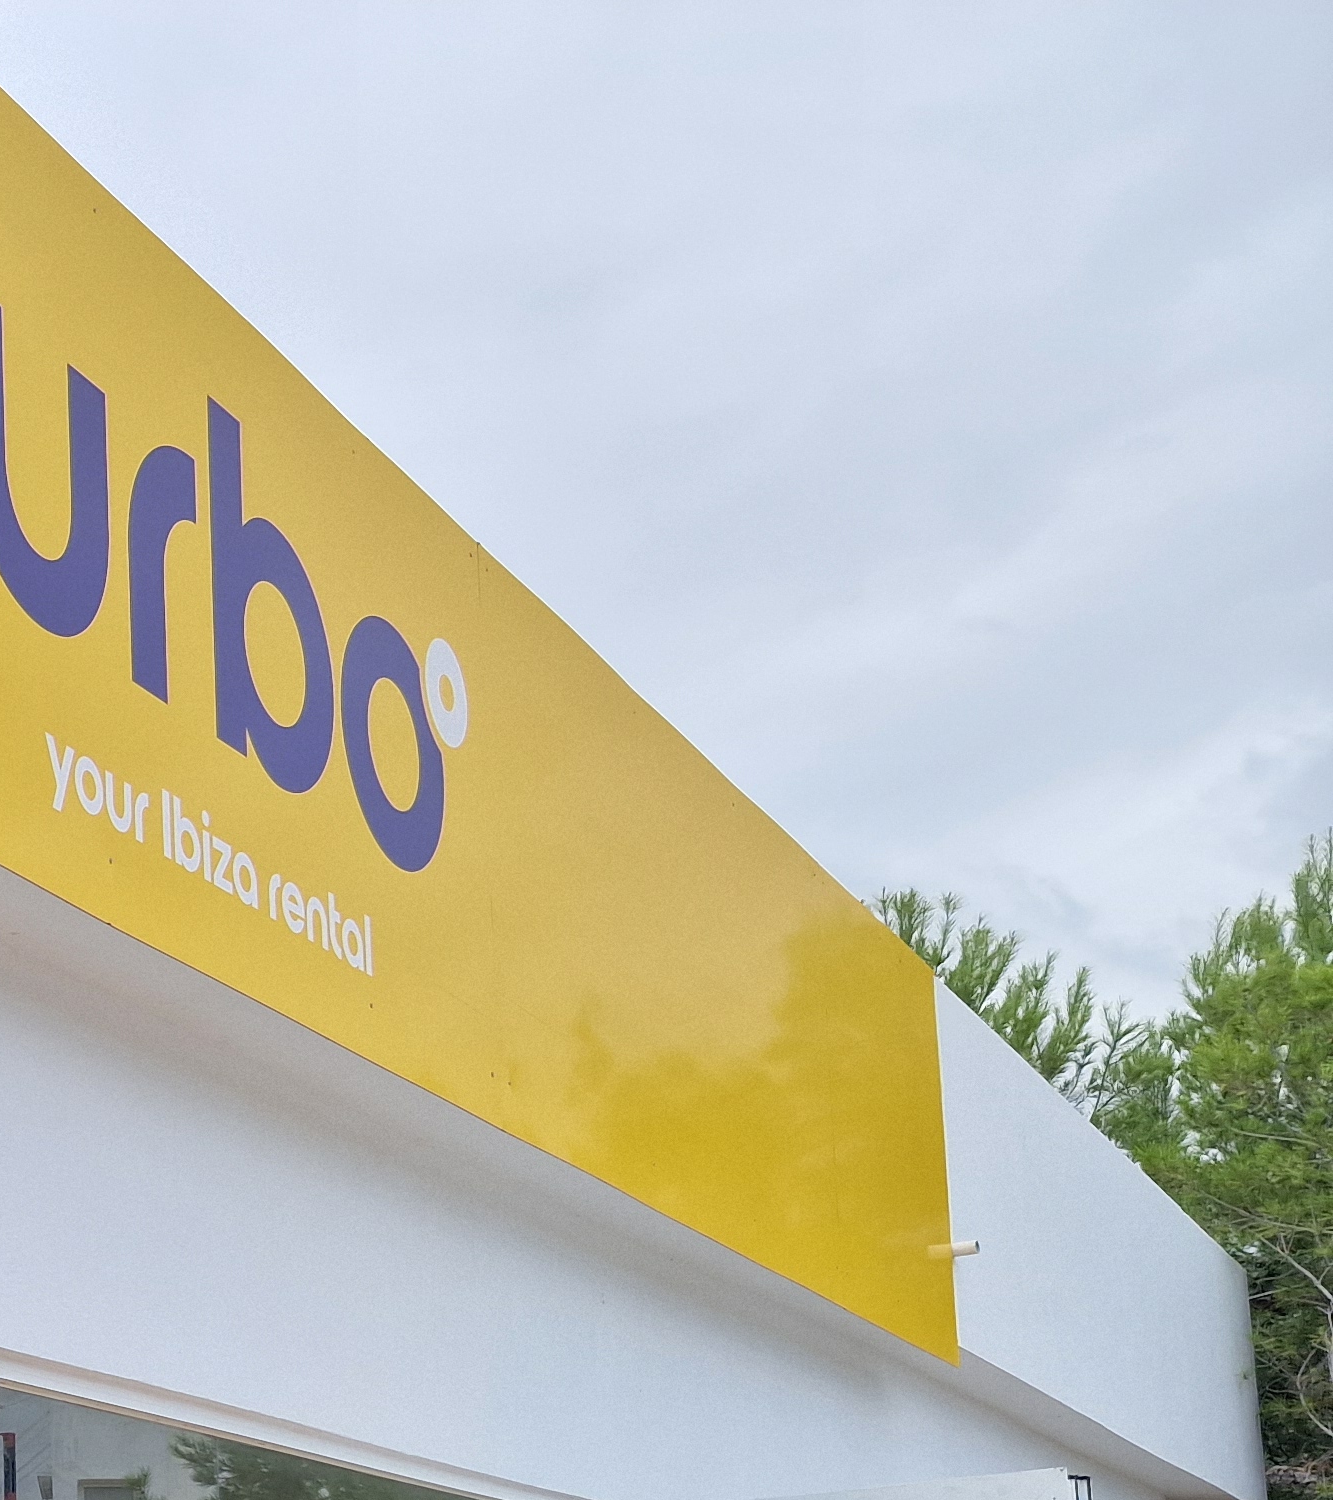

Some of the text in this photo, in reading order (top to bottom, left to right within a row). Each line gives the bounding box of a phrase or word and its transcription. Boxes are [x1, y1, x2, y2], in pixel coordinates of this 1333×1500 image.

[45, 732, 373, 977] your Ibiza rental
